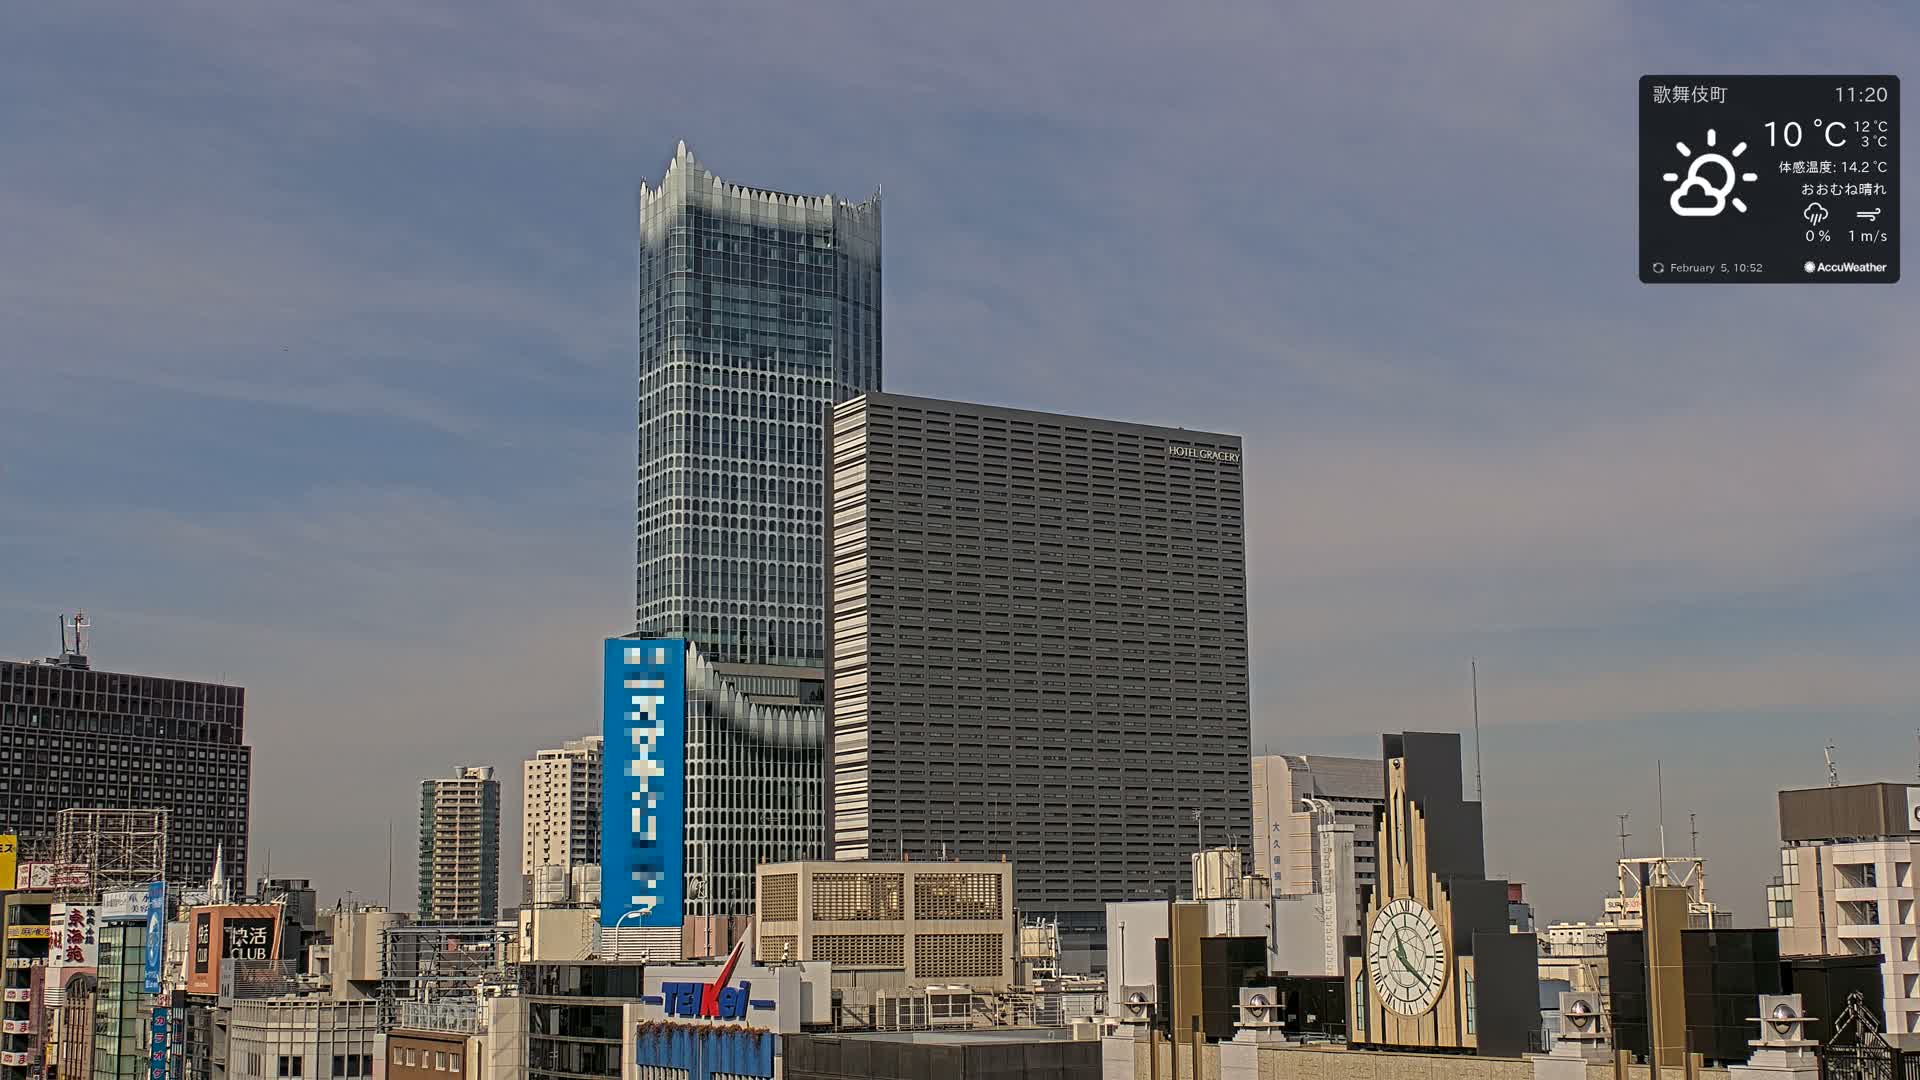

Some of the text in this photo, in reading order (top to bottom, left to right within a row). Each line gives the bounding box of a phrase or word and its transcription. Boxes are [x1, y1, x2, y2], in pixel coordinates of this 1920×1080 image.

[1169, 446, 1240, 462] HOTEL GRACERY
[233, 926, 267, 945] 快活
[231, 947, 266, 960] CLUB
[152, 1016, 165, 1079] カラオケ
